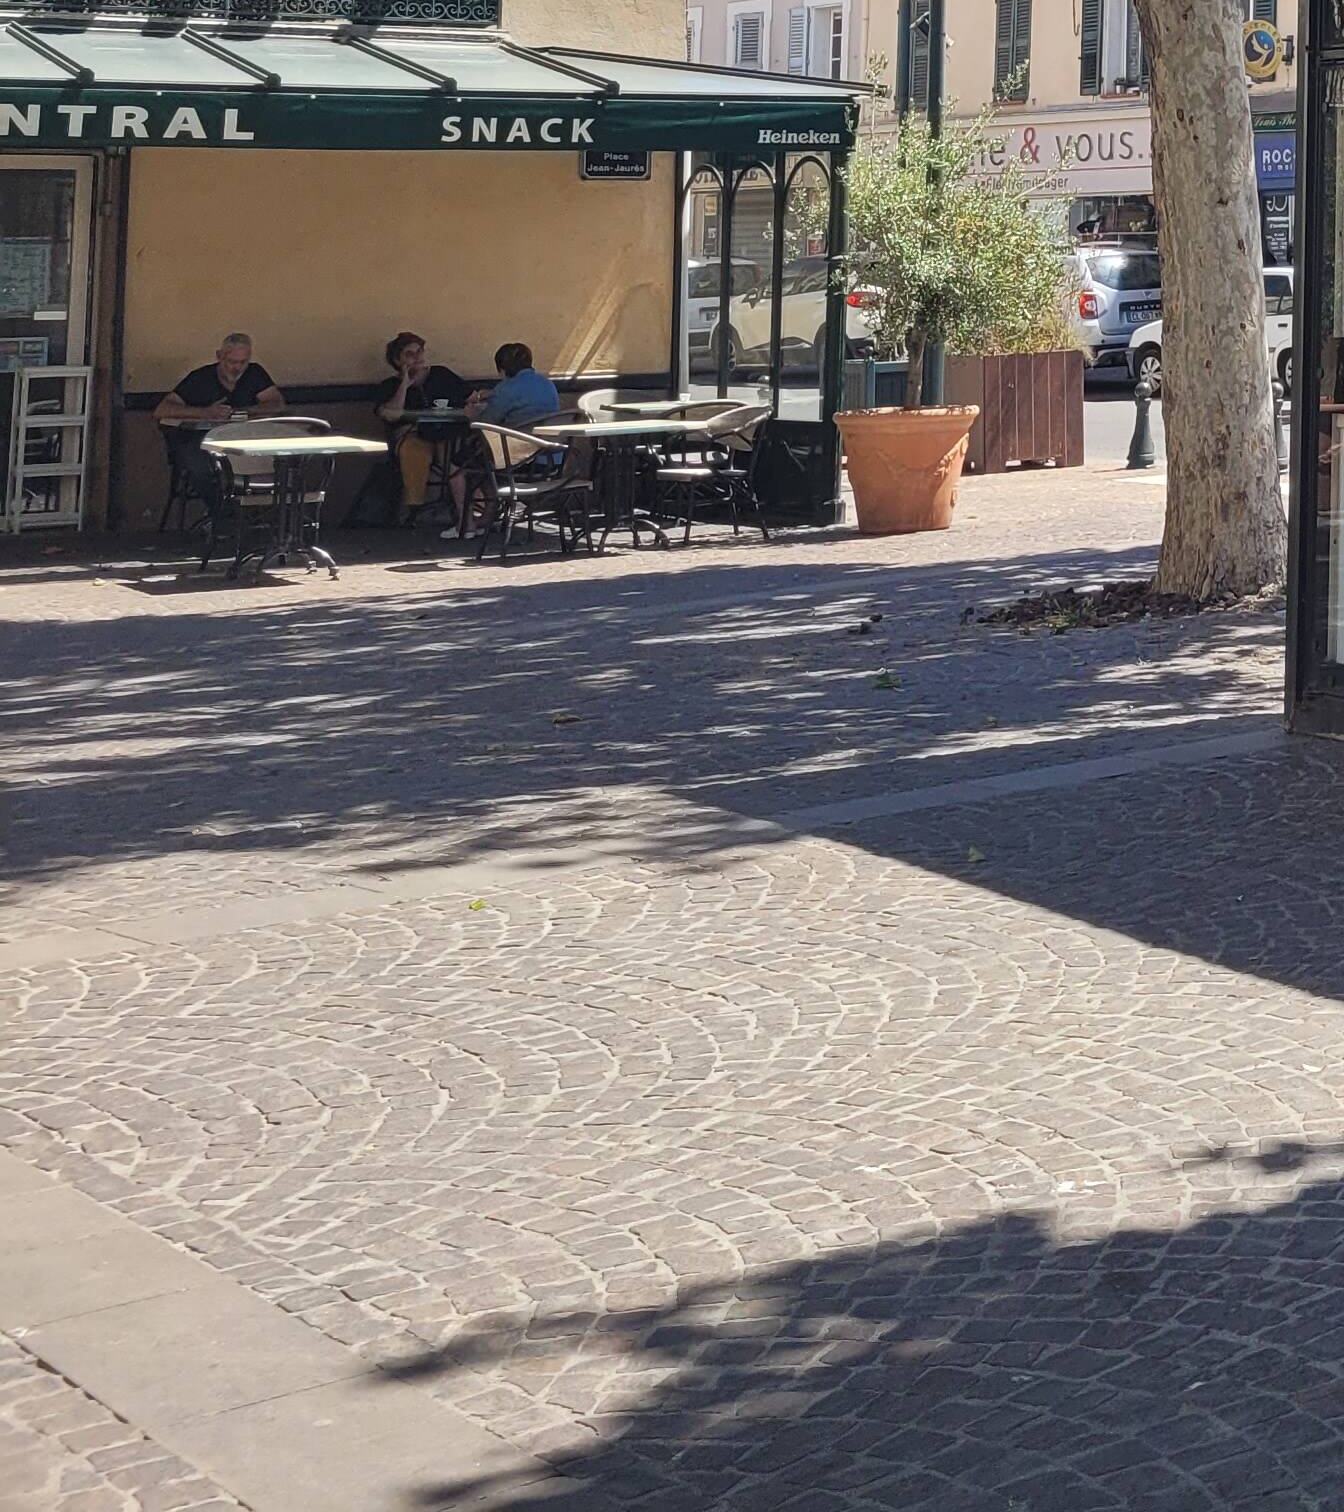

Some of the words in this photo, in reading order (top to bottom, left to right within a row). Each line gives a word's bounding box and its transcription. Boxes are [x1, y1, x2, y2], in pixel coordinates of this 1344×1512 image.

[441, 116, 596, 144] SNACK
[757, 128, 841, 145] Heineken
[604, 152, 629, 160] Place
